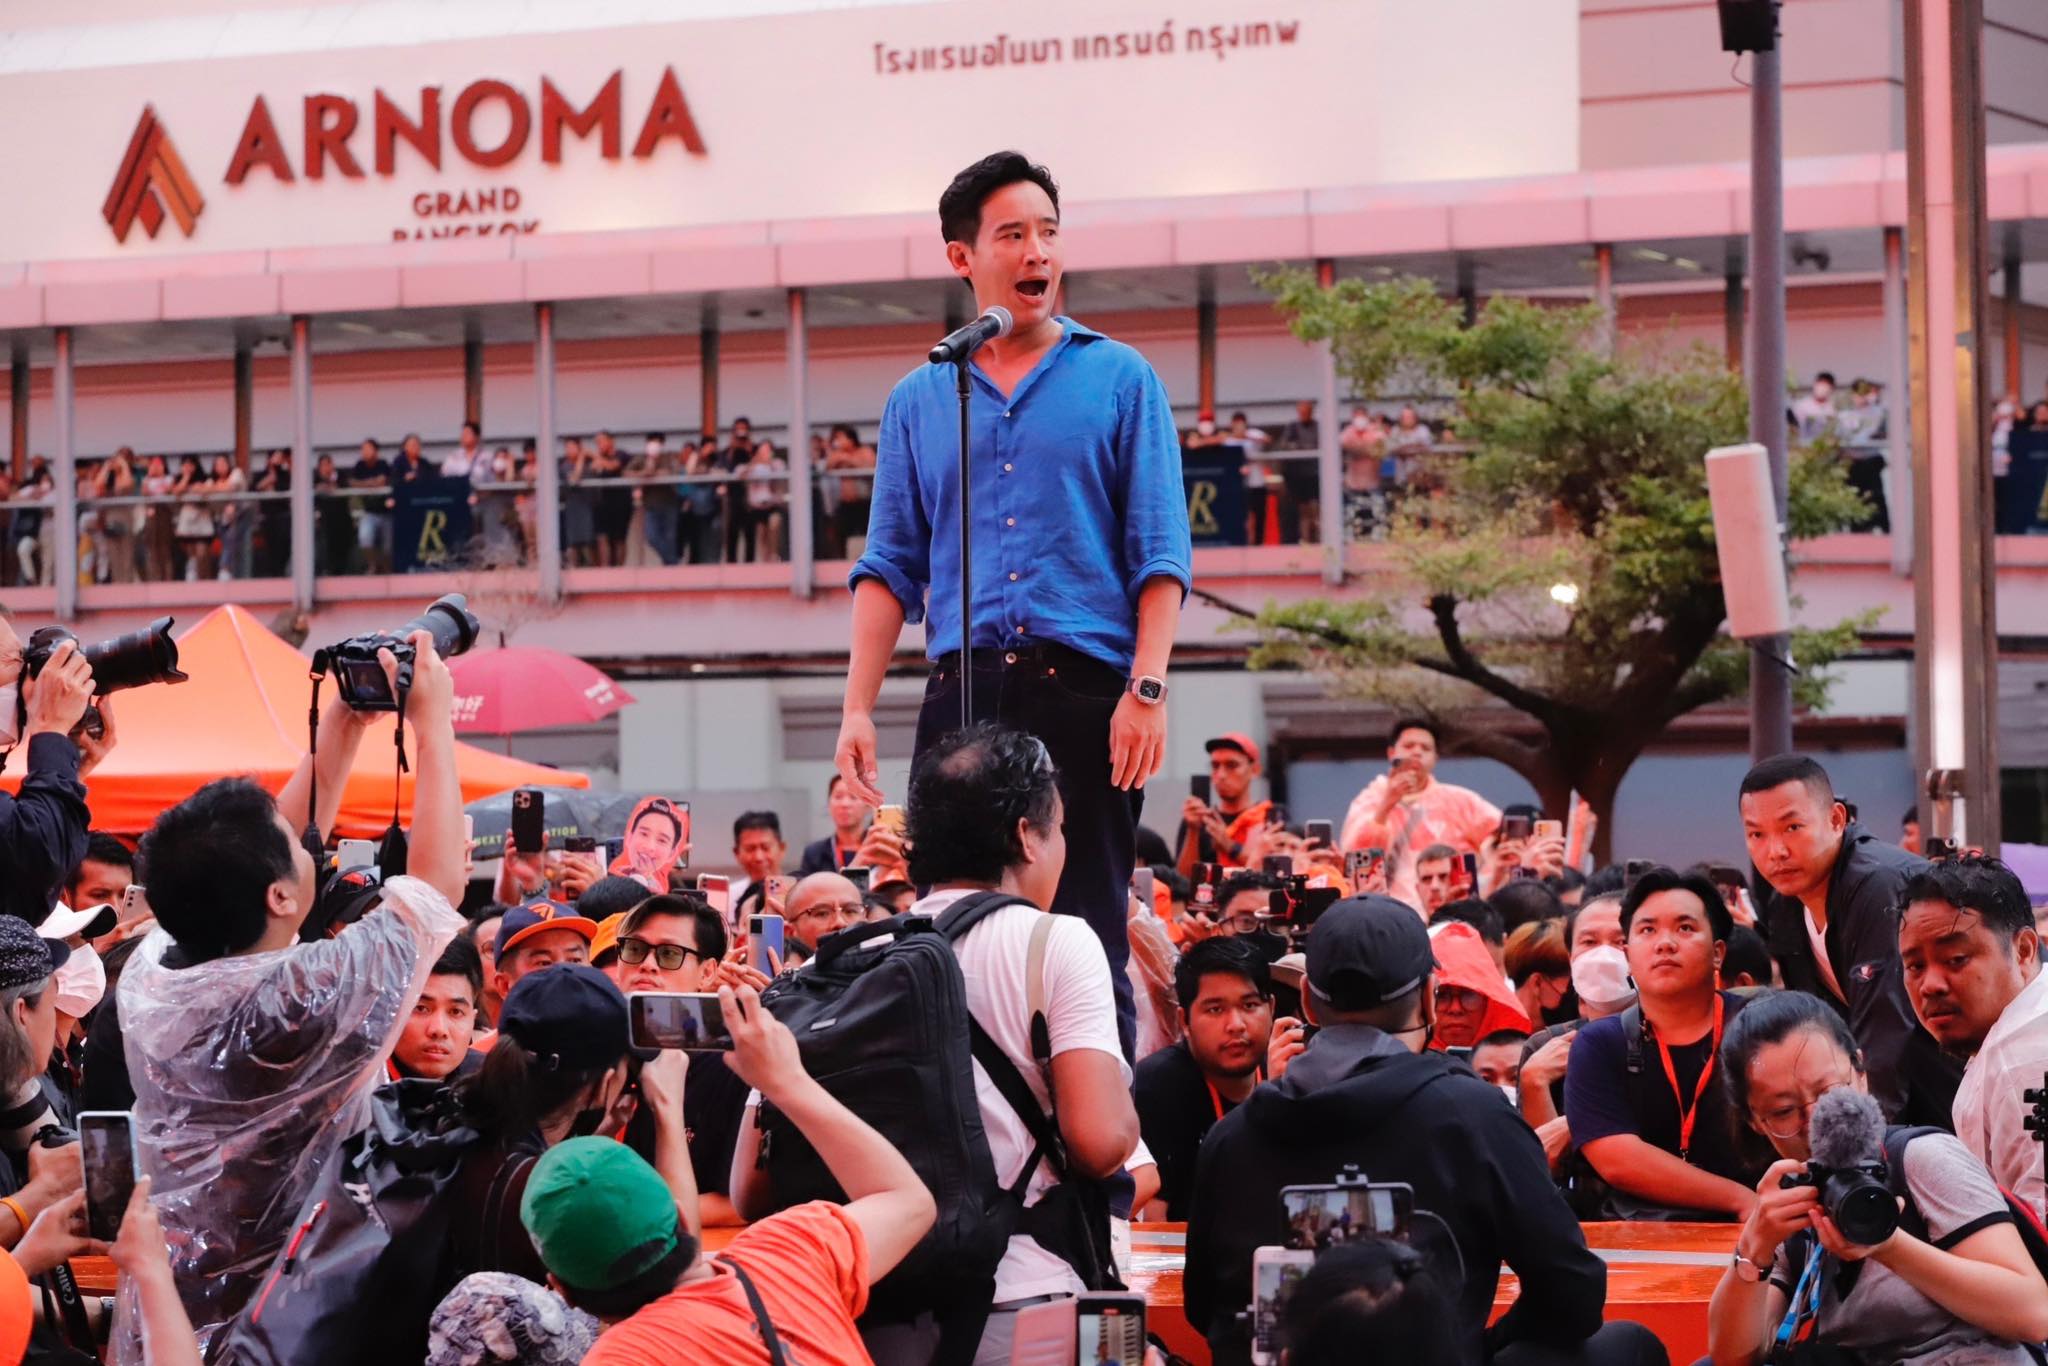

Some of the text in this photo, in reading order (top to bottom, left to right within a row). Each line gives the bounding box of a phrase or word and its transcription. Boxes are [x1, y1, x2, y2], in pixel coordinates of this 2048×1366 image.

[1073, 20, 1174, 60] แกรนด์
[1186, 20, 1299, 62] กรุงเทพ
[223, 64, 708, 184] ARNOMA
[413, 187, 521, 217] GRAND
[55, 1264, 76, 1305] Cano
